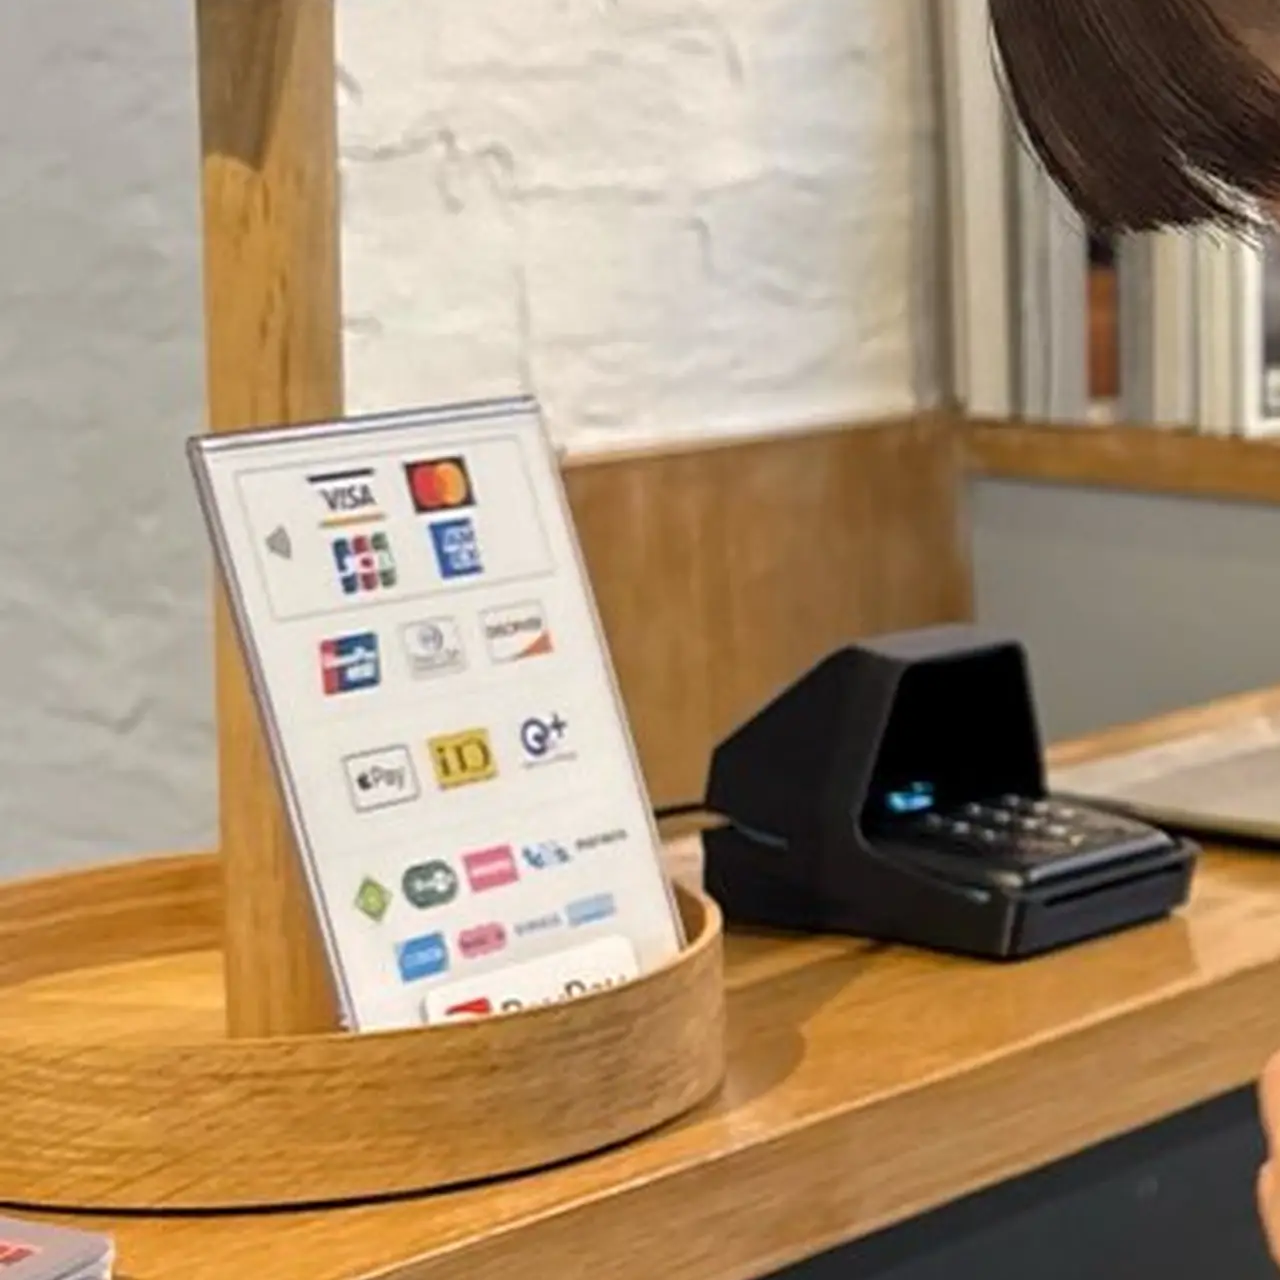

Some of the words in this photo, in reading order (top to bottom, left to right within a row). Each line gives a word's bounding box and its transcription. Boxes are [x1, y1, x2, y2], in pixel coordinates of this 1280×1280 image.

[319, 483, 378, 511] VISA
[436, 737, 491, 777] iD
[371, 766, 406, 791] Pay
